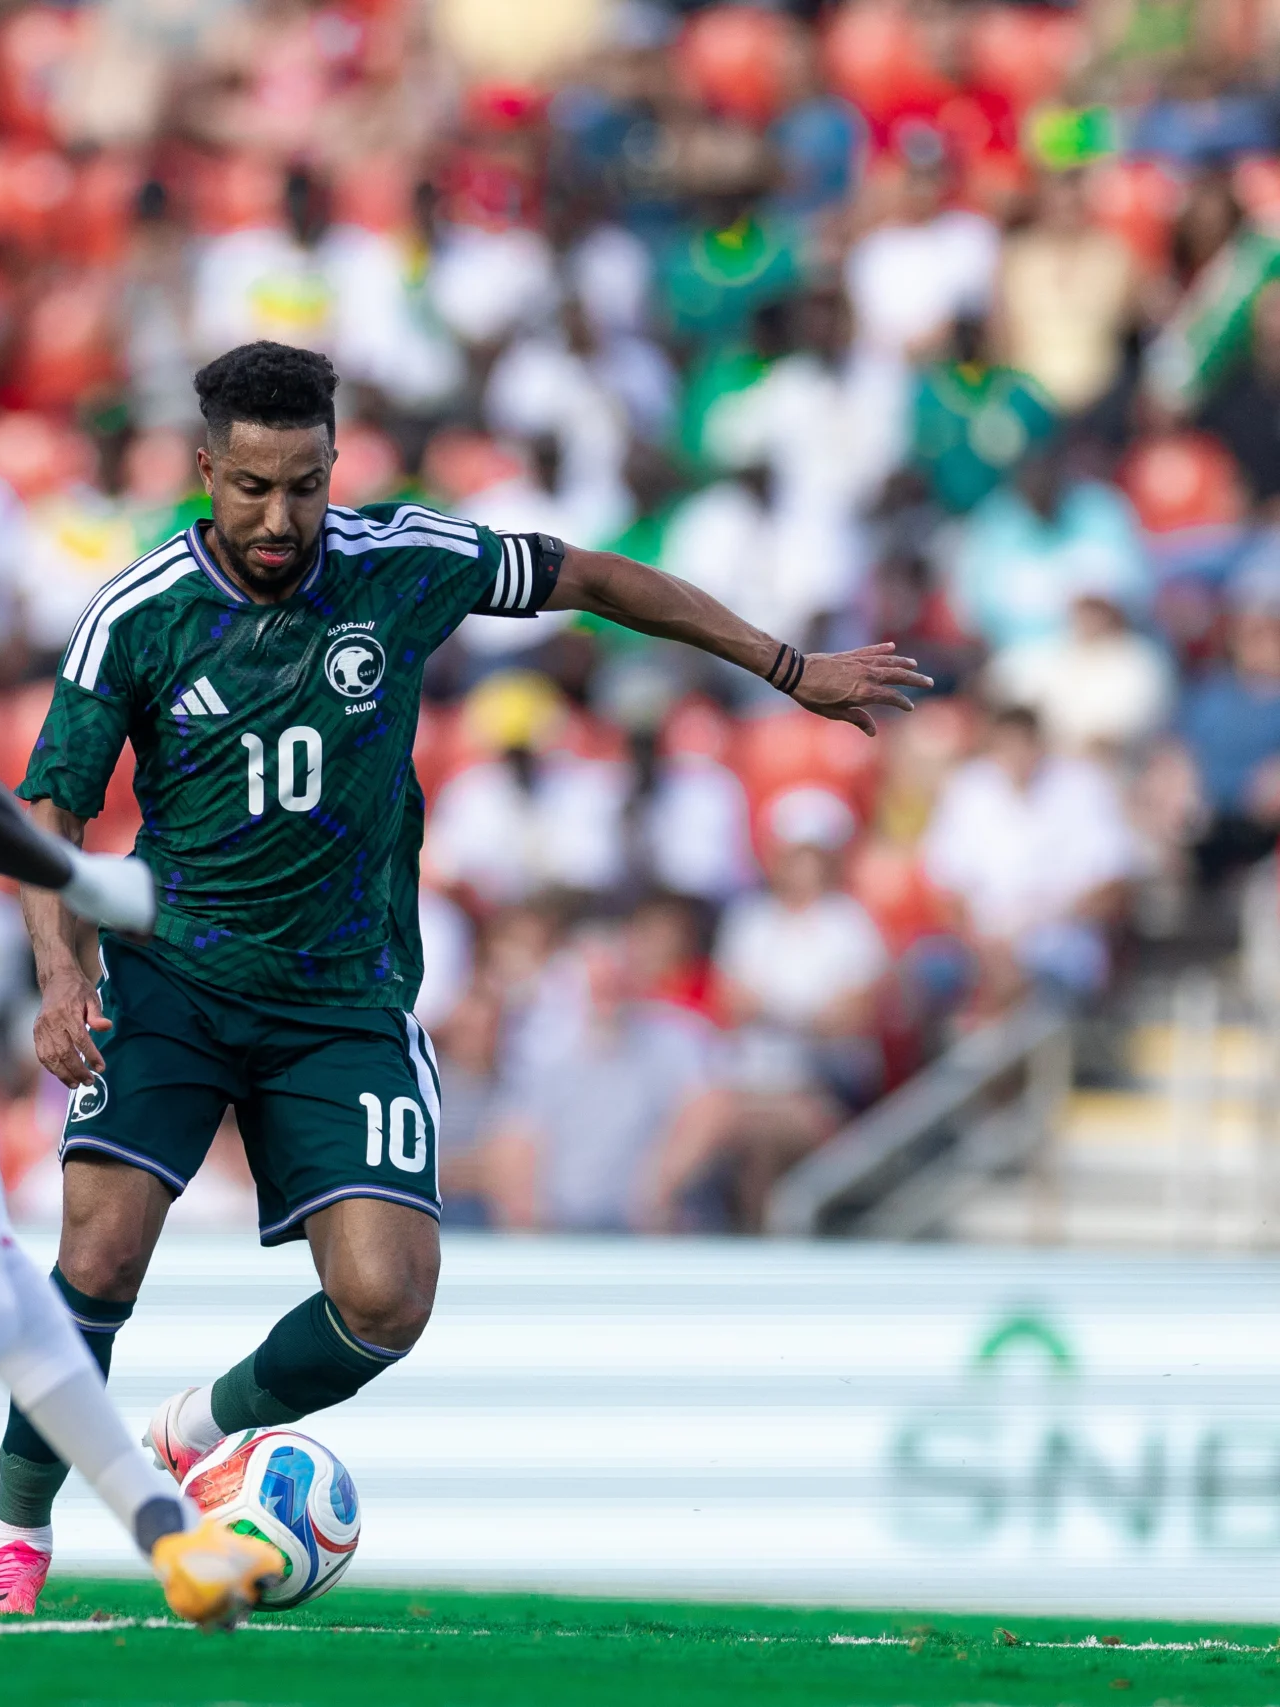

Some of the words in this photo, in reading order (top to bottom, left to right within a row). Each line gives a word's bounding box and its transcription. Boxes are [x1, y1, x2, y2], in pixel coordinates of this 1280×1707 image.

[358, 668, 377, 678] SAFF
[344, 700, 377, 715] SAUDI
[240, 725, 323, 816] 10
[358, 1092, 426, 1173] 10
